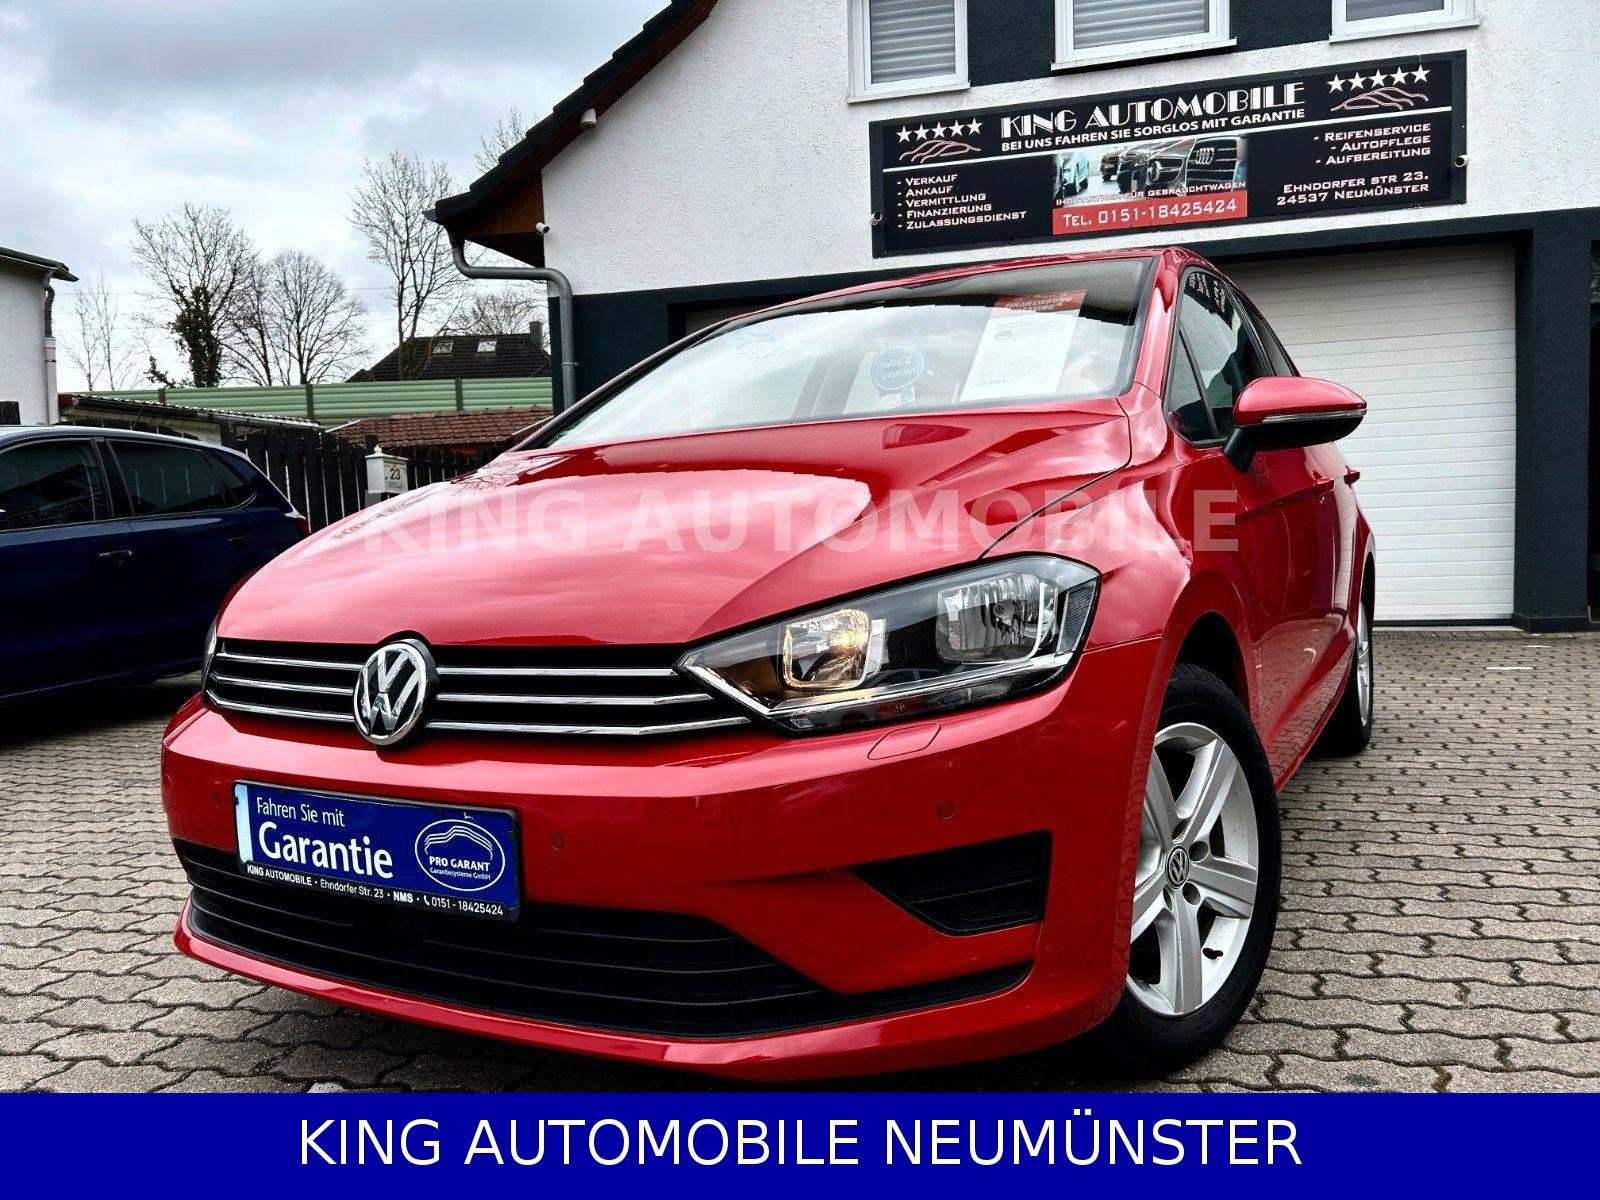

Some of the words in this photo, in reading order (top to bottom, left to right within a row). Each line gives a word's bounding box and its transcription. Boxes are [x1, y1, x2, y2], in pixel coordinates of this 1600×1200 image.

[1000, 109, 1077, 139] KING
[1084, 82, 1305, 126] AUTOMOBILE
[1001, 141, 1023, 151] BEI
[1025, 137, 1053, 150] UNS
[1055, 131, 1108, 146] FAHREN
[1110, 127, 1131, 139] SIE
[1134, 120, 1199, 137] SORGLOS
[1201, 117, 1228, 130] MIT
[1230, 108, 1305, 126] GARANTIE
[1324, 123, 1431, 142] REIFENSERVICE
[1340, 135, 1431, 152] AUTOPFLEGE
[1325, 147, 1431, 165] AUFBEREITUNG
[905, 174, 958, 187] VERKAUF
[1283, 176, 1363, 194] EHNDORFER
[1403, 171, 1429, 182] 23.
[905, 186, 953, 198] ANKAUF
[905, 193, 986, 208] VERMITTLUNG
[1277, 191, 1327, 206] 24537
[1334, 183, 1429, 200] NEUMÜNSTER
[906, 203, 992, 219] FINANZIERUNG
[906, 210, 1027, 230] ZULASSUNGSDIENST
[1062, 213, 1092, 228] TEL.
[1098, 198, 1237, 224] 0151-18425424
[389, 468, 401, 480] 23
[256, 796, 297, 820] Fahren
[300, 804, 319, 823] Sie
[322, 808, 345, 827] mit
[257, 821, 394, 880] Garantie
[428, 855, 449, 868] PRO
[450, 858, 491, 872] GARANT
[246, 864, 265, 876] KING
[265, 868, 313, 887] AUTOMOBILE
[320, 878, 358, 894] Ehndorfer
[358, 885, 373, 898] Str.
[373, 888, 384, 899] 23
[392, 890, 414, 904] NMS
[472, 872, 491, 880] GmbH
